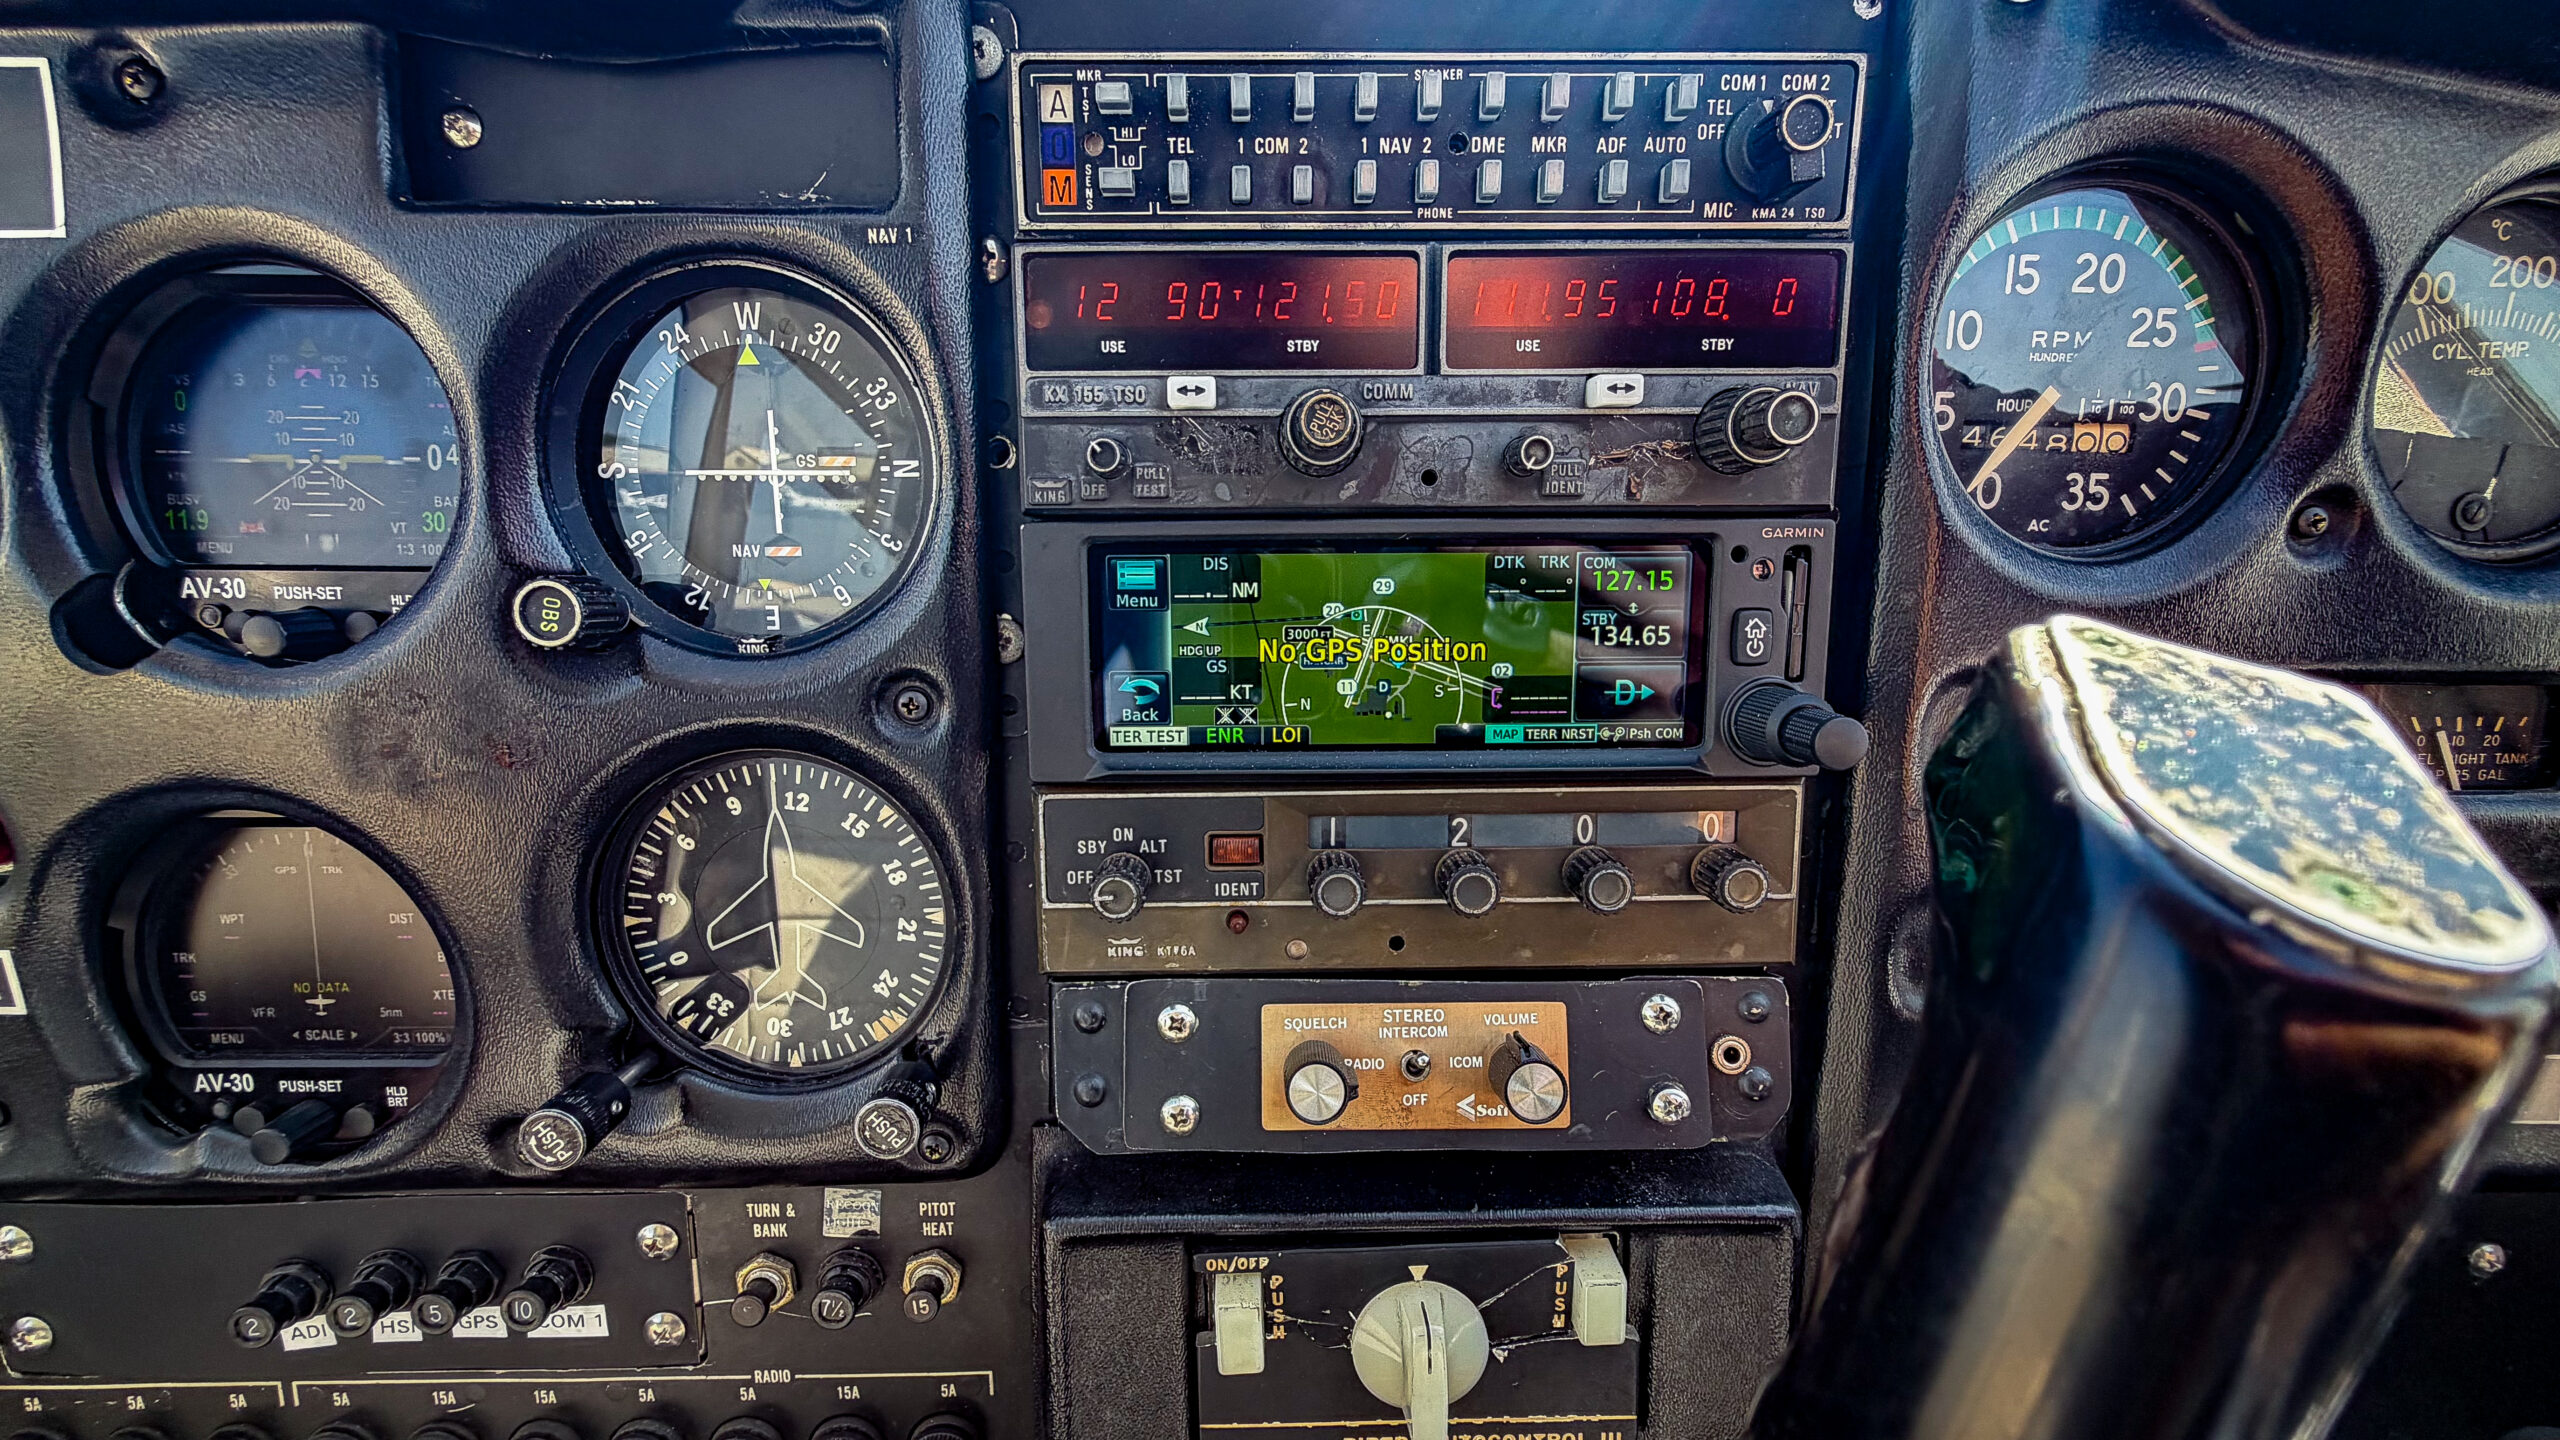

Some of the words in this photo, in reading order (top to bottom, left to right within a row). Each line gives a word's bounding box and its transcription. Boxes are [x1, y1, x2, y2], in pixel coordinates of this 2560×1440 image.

[1077, 70, 1101, 81] MKR
[1721, 76, 1756, 91] COM
[1760, 76, 1766, 91] 1
[1782, 75, 1817, 91] COM
[1820, 75, 1830, 91] 2
[1049, 90, 1068, 118] A
[1707, 100, 1733, 115] TEL
[1122, 127, 1133, 138] HI
[1698, 124, 1725, 140] OFF
[1167, 138, 1194, 154] TEL
[1238, 138, 1243, 154] 1
[1255, 138, 1289, 154] COM
[1299, 138, 1308, 154] 2
[1361, 138, 1367, 153] 1
[1380, 137, 1412, 154] NAV
[1423, 137, 1431, 153] 2
[1472, 137, 1505, 153] DME
[1532, 137, 1567, 152] MKR
[1597, 137, 1627, 152] ADF
[1644, 137, 1686, 153] AUTO
[1122, 155, 1135, 166] LO
[1050, 175, 1073, 203] M
[1418, 207, 1453, 218] PHONE
[1703, 203, 1732, 218] MIC
[1752, 207, 1776, 218] KMA
[1781, 207, 1795, 218] 24
[1805, 207, 1825, 218] TSO
[868, 228, 897, 244] NAV
[906, 227, 912, 243] 1
[2004, 254, 2040, 296] 15
[2072, 252, 2126, 294] 20
[2489, 255, 2557, 288] 200
[733, 302, 761, 330] W
[1946, 310, 1983, 351] 10
[2127, 308, 2178, 348] 25
[659, 322, 690, 353] 24
[808, 322, 841, 353] 30
[1701, 338, 1734, 351] STBY
[1101, 341, 1126, 353] USE
[1287, 340, 1319, 353] STBY
[1516, 340, 1540, 352] USE
[2433, 343, 2472, 360] CYL.
[2479, 342, 2530, 357] TEMP.
[2467, 367, 2494, 376] HEAD
[611, 379, 640, 410] 21
[866, 377, 897, 410] 33
[1043, 386, 1067, 403] KX
[1075, 386, 1103, 403] 155
[1115, 386, 1146, 403] TSO
[1364, 384, 1413, 400] COMM
[2139, 382, 2187, 422] 30
[796, 455, 816, 467] GS
[598, 462, 626, 479] S
[893, 460, 919, 478] N
[1136, 468, 1165, 480] PULL
[1552, 465, 1580, 476] PULL
[1083, 484, 1105, 496] OFF
[1136, 485, 1165, 496] TEST
[1546, 481, 1585, 494] IDENT
[2061, 472, 2109, 511] 35
[1035, 491, 1065, 503] KING
[1762, 528, 1824, 539] GARMIN
[732, 545, 761, 558] NAV
[1203, 557, 1228, 571] DIS
[1494, 556, 1525, 569] DTK
[1539, 556, 1570, 568] TRK
[1584, 557, 1616, 569] COM
[1376, 581, 1392, 591] 29
[1593, 570, 1674, 591] 127.15
[181, 578, 246, 599] AV-30
[274, 587, 342, 600] PUSH-SET
[1232, 582, 1258, 598] NM
[1116, 595, 1158, 608] Menu
[540, 597, 561, 632] OBS
[766, 606, 780, 630] E
[1582, 613, 1617, 626] STBY
[1591, 625, 1671, 646] 134.65
[738, 644, 769, 653] KING
[1179, 646, 1203, 656] HDG
[1206, 646, 1221, 656] UP
[1259, 638, 1296, 663] No
[1306, 638, 1362, 663] GPS
[1373, 637, 1487, 663] Position
[1206, 660, 1227, 673] GS
[1494, 664, 1509, 676] 02
[1230, 685, 1253, 699] KT
[1434, 685, 1444, 697] S
[1300, 698, 1311, 710] N
[1122, 709, 1159, 722] Back
[1113, 730, 1147, 742] TER
[1150, 730, 1184, 742] TEST
[1207, 729, 1245, 743] ENR
[1272, 728, 1301, 742] LOI
[1493, 729, 1518, 740] MAP
[1526, 729, 1557, 740] TERR
[1561, 729, 1594, 739] NRST
[1630, 728, 1651, 739] Psh
[1656, 728, 1683, 738] COM
[2483, 735, 2500, 746] 20
[2478, 769, 2507, 780] GAL
[784, 792, 810, 812] 12
[841, 813, 871, 838] 15
[1113, 828, 1133, 841] ON
[1077, 840, 1107, 854] SBY
[1139, 839, 1167, 853] ALT
[275, 866, 297, 874] GPS
[322, 866, 343, 874] TRK
[882, 859, 908, 886] 18
[1154, 869, 1182, 883] TST
[1067, 871, 1093, 884] OFF
[1214, 883, 1259, 897] IDENT
[220, 914, 245, 924] WPT
[389, 913, 415, 924] DIST
[1108, 946, 1143, 957] KING
[294, 983, 311, 993] NO
[318, 983, 350, 993] DATA
[252, 1008, 276, 1018] VFR
[380, 1007, 403, 1018] 5nm
[1383, 1009, 1445, 1023] STEREO
[1484, 1013, 1538, 1026] VOLUME
[1284, 1017, 1347, 1031] SQUELCH
[211, 1033, 244, 1044] MENU
[306, 1030, 344, 1041] SCALE
[1379, 1026, 1448, 1039] INTERCOM
[1450, 1056, 1482, 1068] ICOM
[195, 1074, 254, 1093] AV-30
[279, 1080, 342, 1092] PUSH-SET
[386, 1087, 407, 1096] HLD
[388, 1097, 408, 1107] BRT
[1403, 1094, 1427, 1106] OFF
[866, 1111, 907, 1148] PUSH
[532, 1121, 573, 1161] PUSH
[746, 1204, 780, 1218] TURN
[786, 1203, 795, 1217] &
[919, 1202, 955, 1216] PITOT
[753, 1224, 787, 1237] BANK
[922, 1222, 954, 1236] HEAT
[459, 1315, 498, 1329] GPS
[291, 1324, 327, 1341] ADI
[754, 1370, 791, 1383] RADIO
[533, 1389, 557, 1404] 15A
[638, 1388, 655, 1403] 5A
[740, 1387, 756, 1401] 5A
[837, 1386, 860, 1400] 15A
[940, 1383, 956, 1398] 5A
[23, 1398, 42, 1412] 5A
[127, 1396, 145, 1411] 5A
[229, 1394, 248, 1408] 5A
[332, 1392, 350, 1407] 5A
[432, 1390, 456, 1406] 15A
